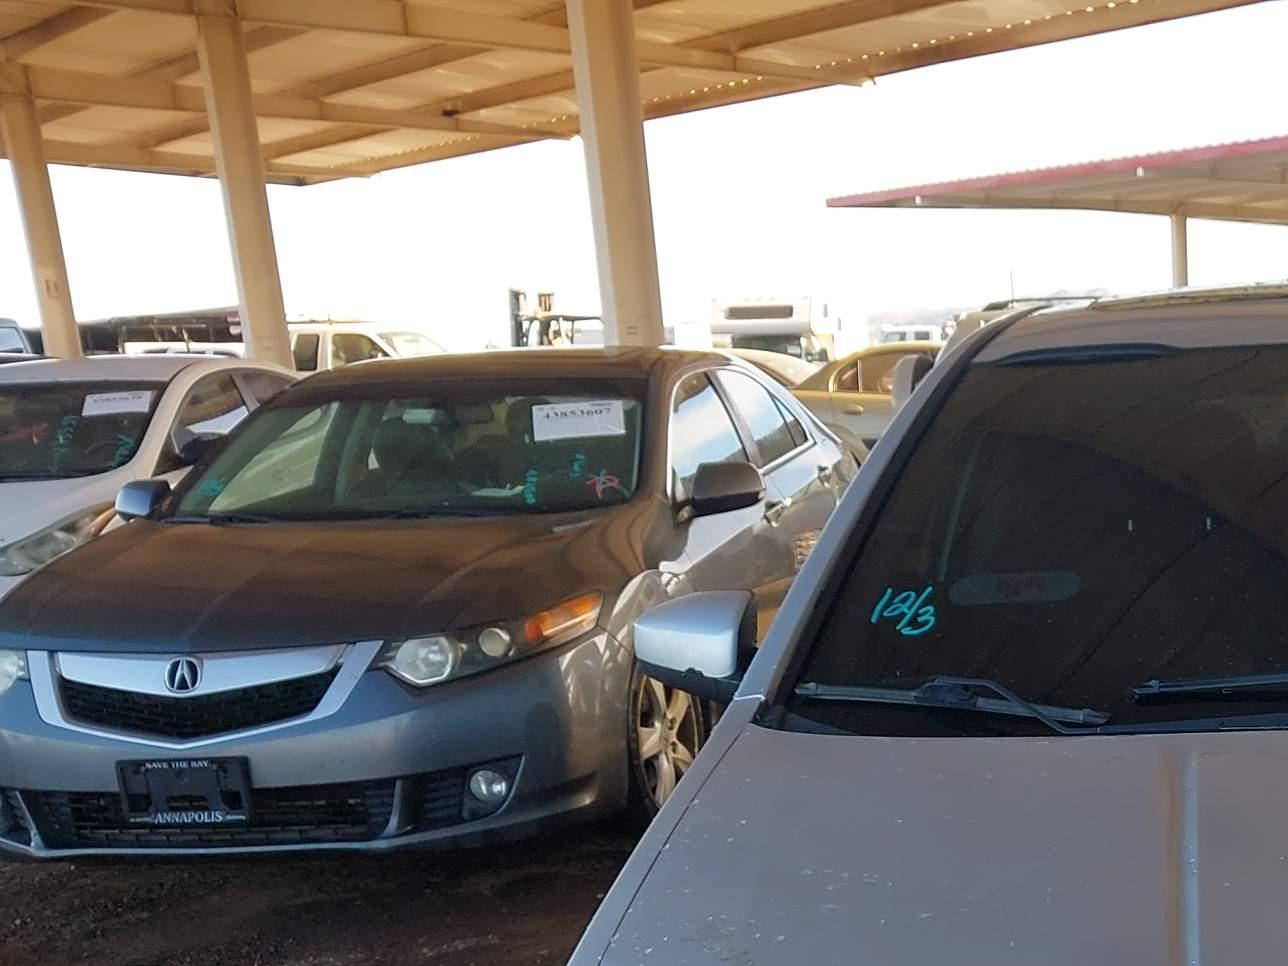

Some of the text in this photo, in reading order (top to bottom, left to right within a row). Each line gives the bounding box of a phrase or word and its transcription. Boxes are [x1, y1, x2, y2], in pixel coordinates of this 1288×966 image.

[145, 760, 209, 770] SAVE THE BAY
[154, 811, 224, 824] ANNAPOLIS
